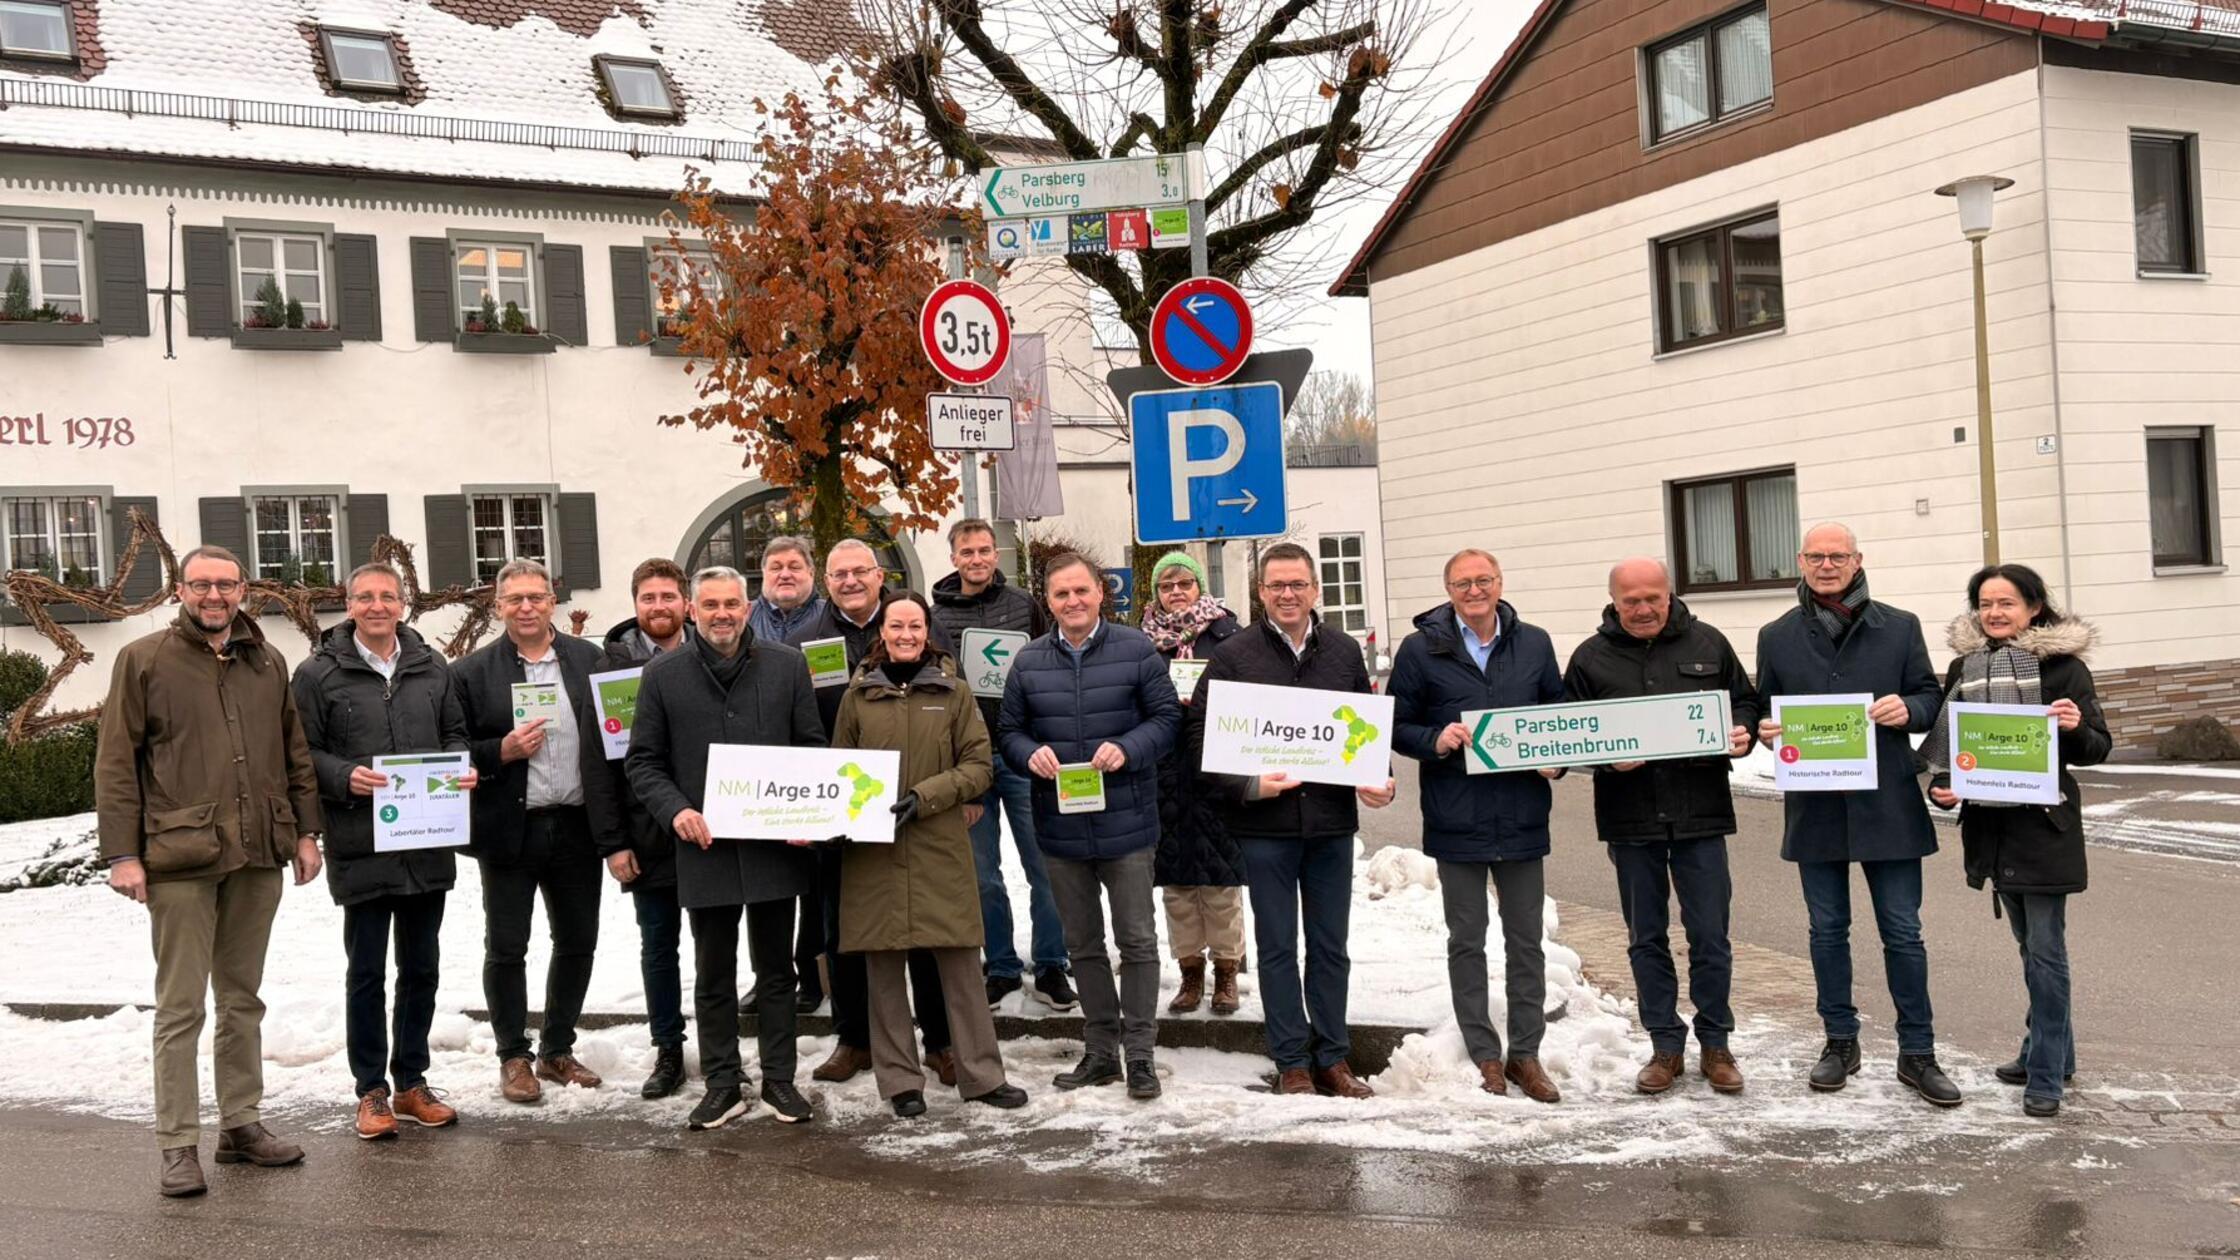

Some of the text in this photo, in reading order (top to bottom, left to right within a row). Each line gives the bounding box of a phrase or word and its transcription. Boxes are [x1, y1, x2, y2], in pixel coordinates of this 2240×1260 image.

[1021, 163, 1167, 188] Parsberg 15
[1022, 191, 1080, 208] Velburg
[1072, 244, 1106, 254] LABER
[938, 404, 1004, 425] Anlieger
[62, 417, 135, 449] 1978
[960, 424, 987, 442] frei
[1167, 408, 1247, 522] P
[609, 721, 617, 731] 1
[1515, 703, 1705, 735] Parsberg 22
[1786, 722, 1848, 733] NM Arge 10
[1217, 715, 1335, 742] NM Arge 10
[1964, 731, 2029, 743] NM Arge 10
[1518, 735, 1639, 760] Breitenbrunn
[1785, 749, 1793, 760] 1
[1961, 756, 1970, 767] 2
[718, 780, 840, 802] NM Arge 10
[385, 808, 393, 820] 3
[427, 826, 456, 835] Radtour
